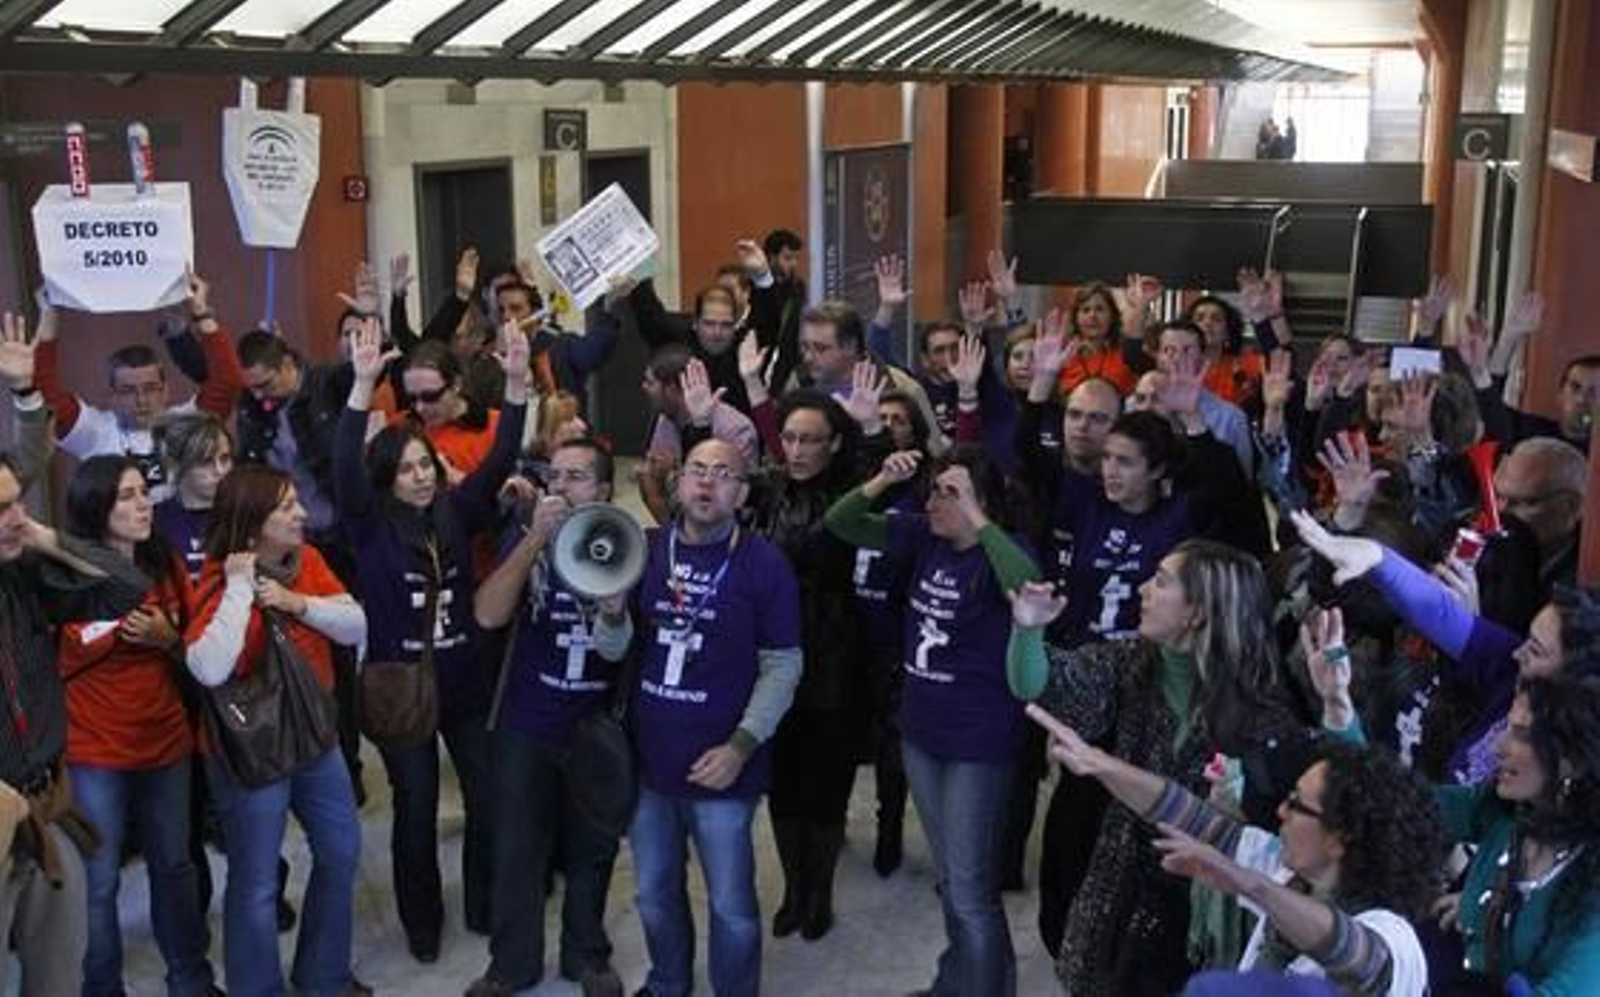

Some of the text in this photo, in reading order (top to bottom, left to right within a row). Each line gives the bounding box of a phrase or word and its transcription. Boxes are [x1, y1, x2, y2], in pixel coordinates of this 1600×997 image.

[556, 122, 578, 150] C
[1464, 129, 1491, 160] C
[64, 221, 158, 239] DECRETO
[84, 250, 148, 267] 5/2010
